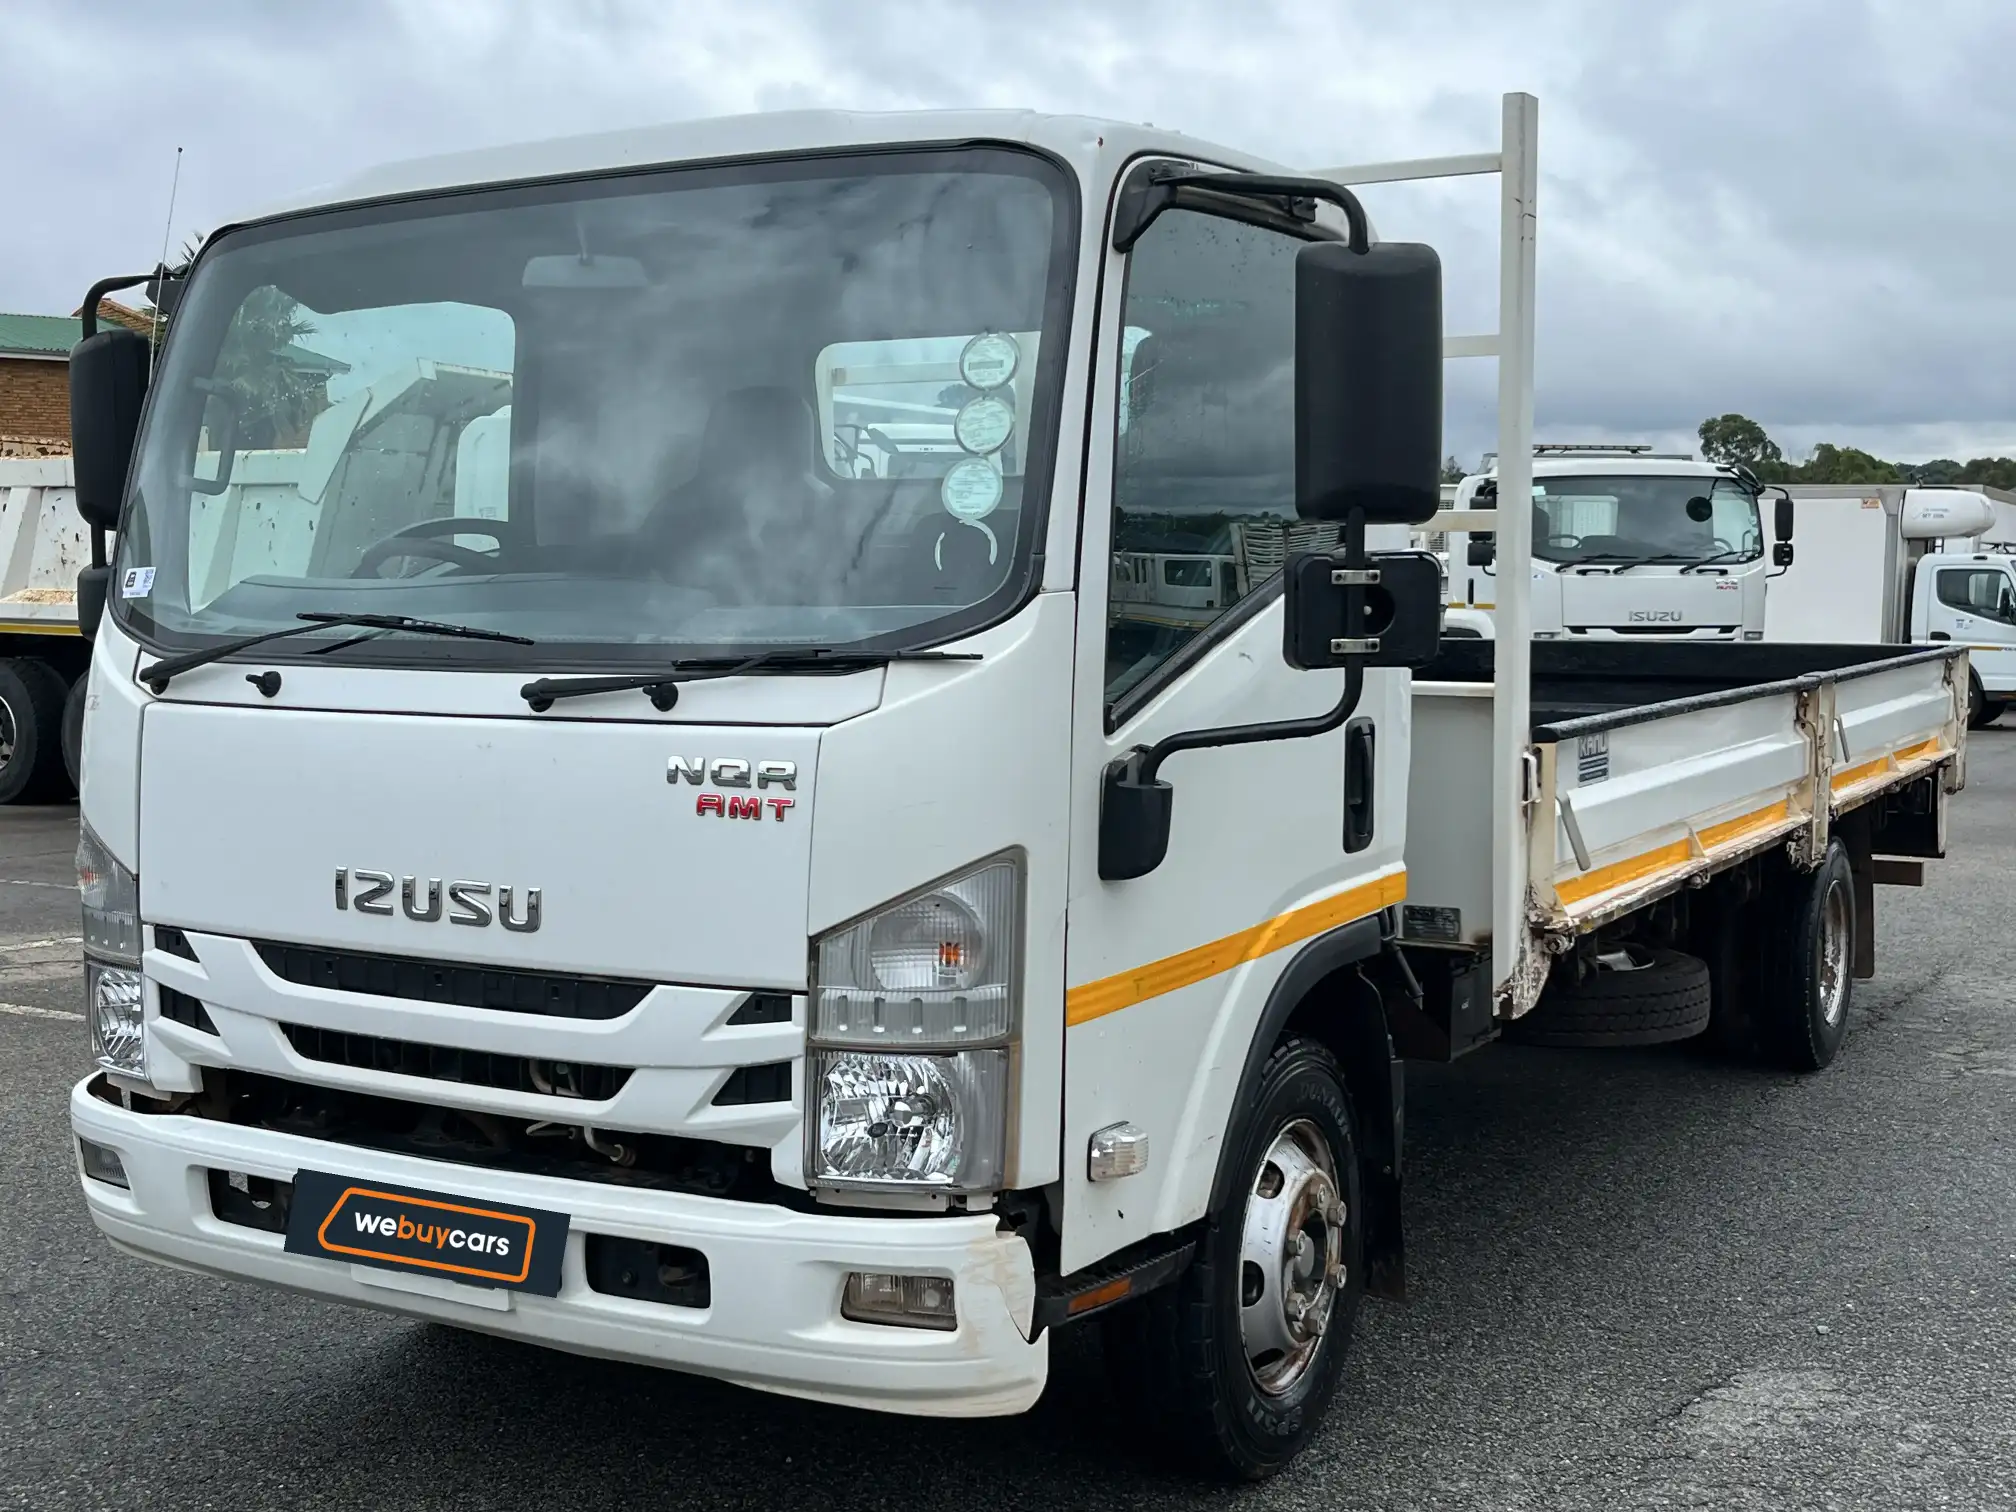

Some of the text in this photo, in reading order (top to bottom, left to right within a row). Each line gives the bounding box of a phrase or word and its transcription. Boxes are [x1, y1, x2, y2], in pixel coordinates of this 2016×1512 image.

[1628, 610, 1683, 622] ISUZU
[667, 754, 797, 790] NQR
[696, 791, 795, 822] AMT
[335, 865, 542, 932] IZUSU
